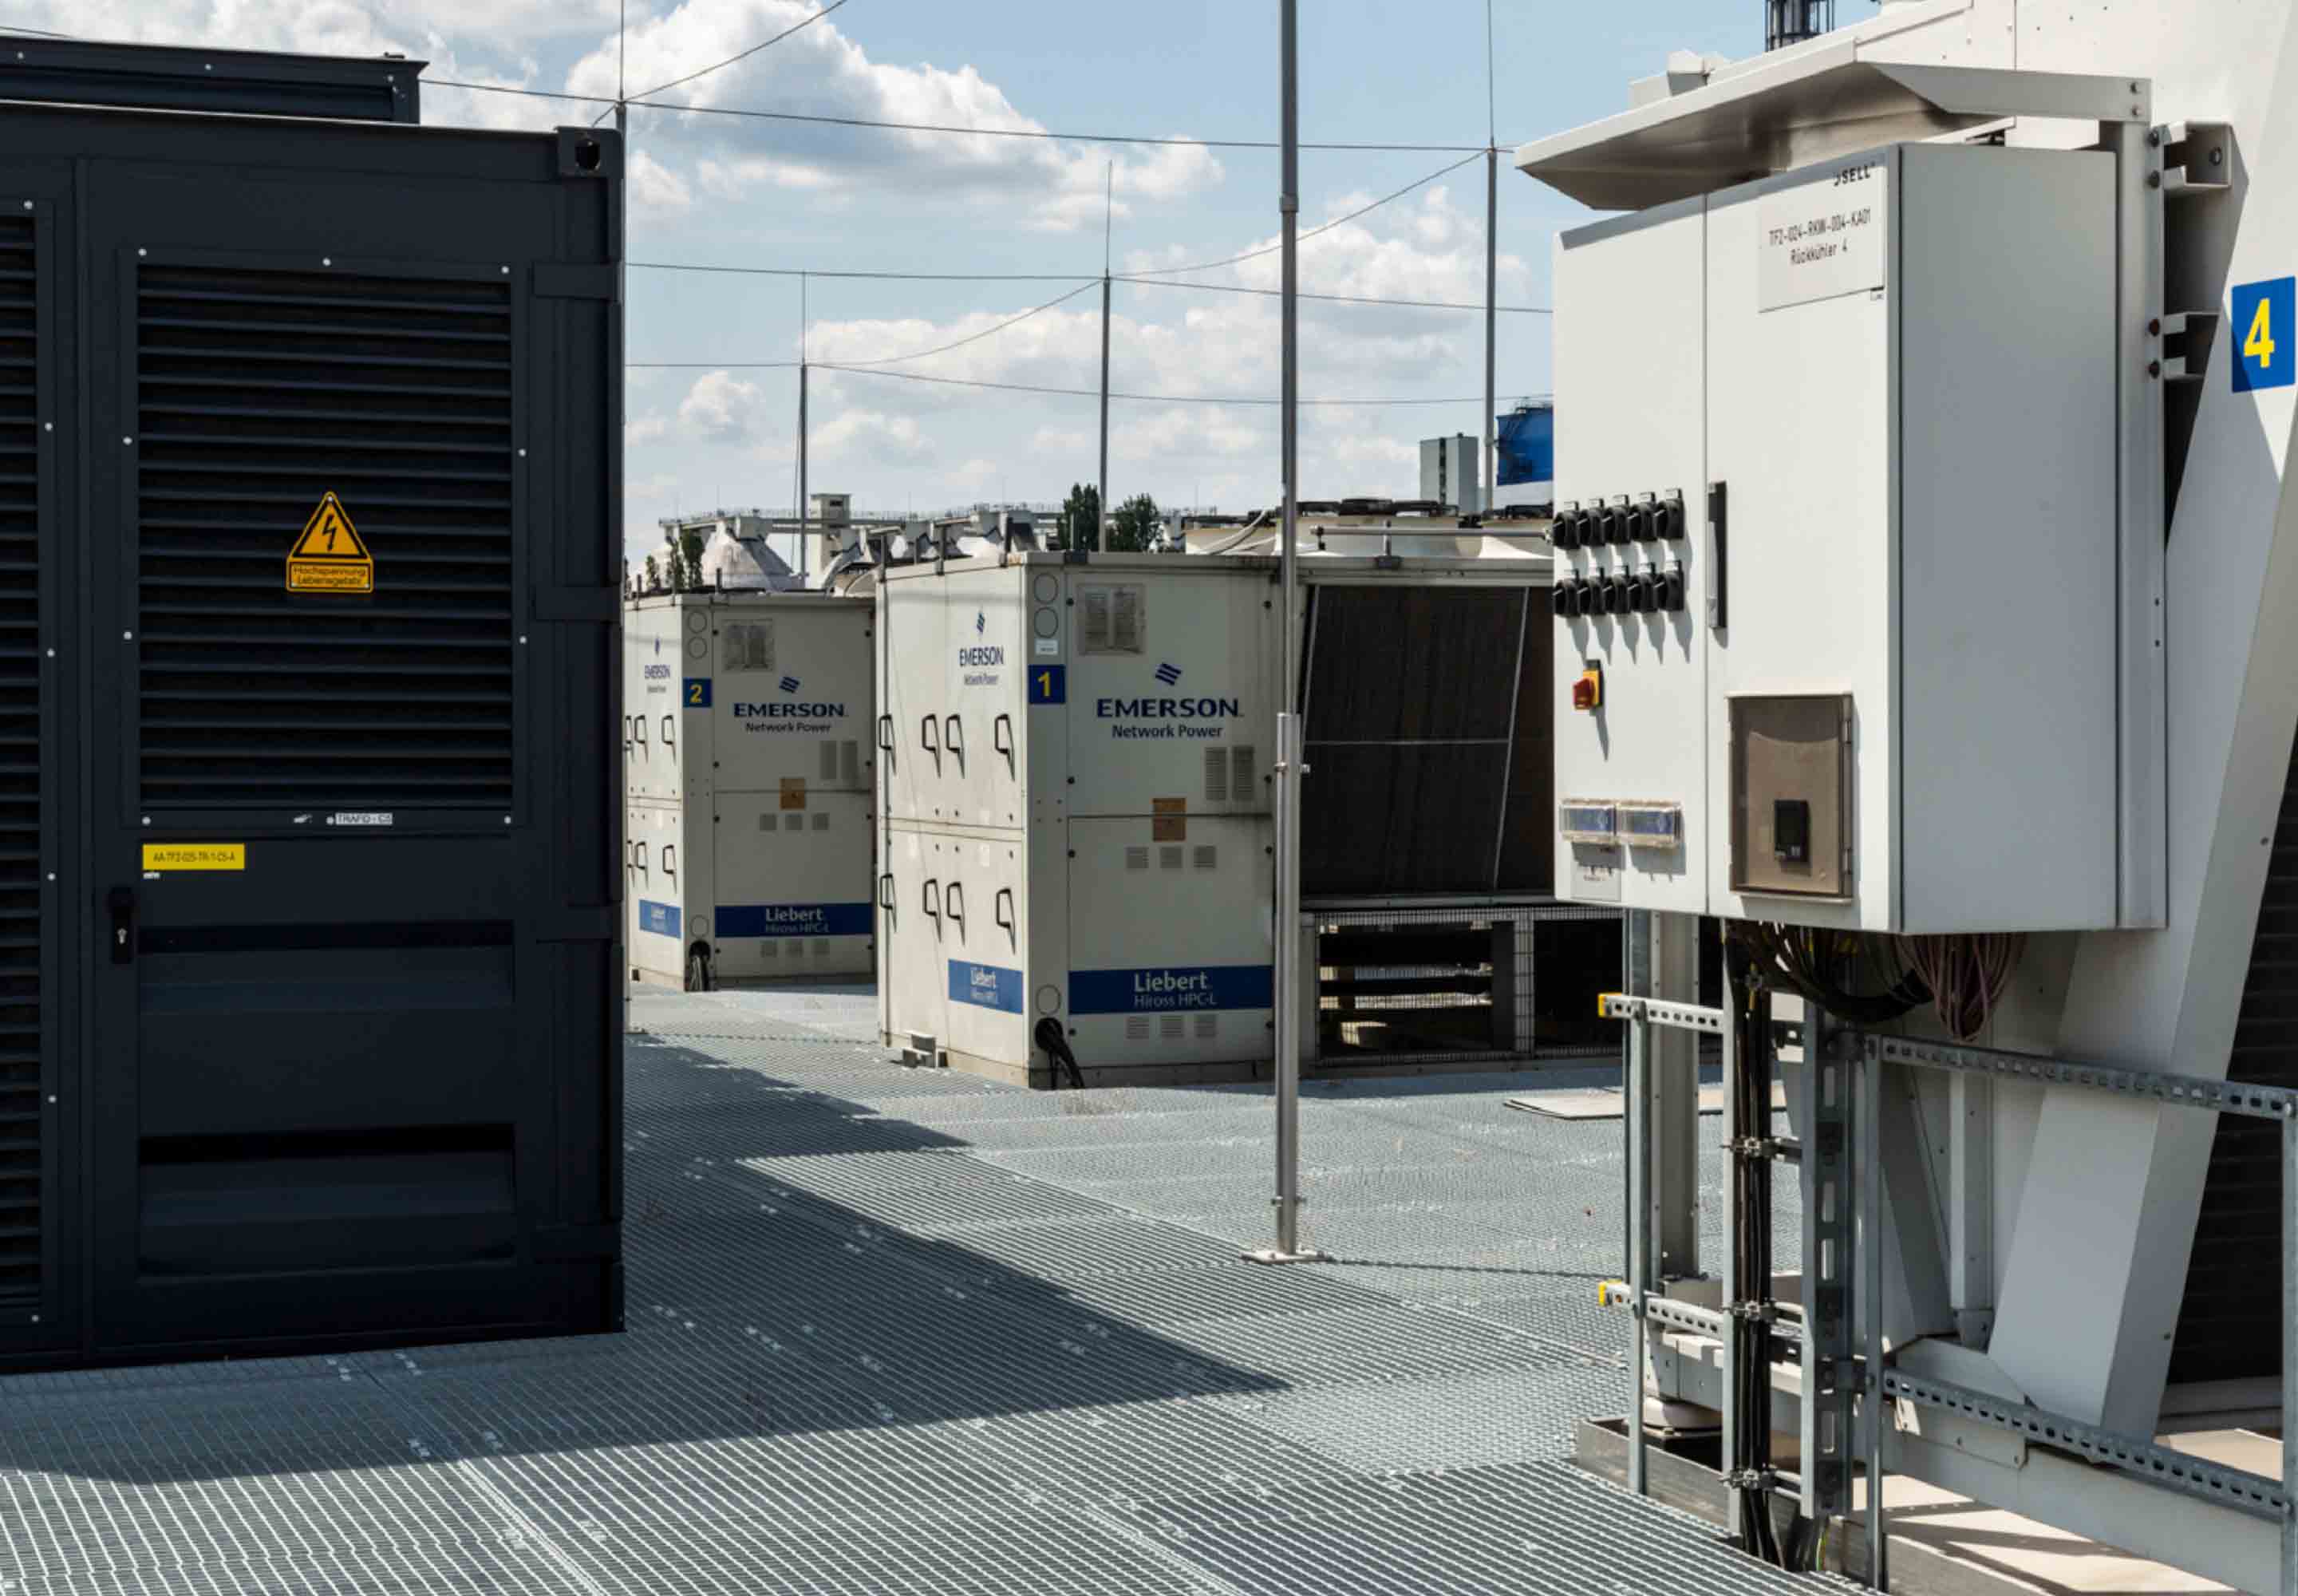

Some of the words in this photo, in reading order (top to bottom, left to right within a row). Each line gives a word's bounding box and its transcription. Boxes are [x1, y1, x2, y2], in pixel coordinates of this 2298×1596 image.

[1842, 238, 1848, 252] 4
[2244, 298, 2275, 368] 4
[959, 646, 1004, 667] EMERSON
[1038, 672, 1050, 697] 1
[690, 684, 702, 703] 2
[733, 703, 844, 717] EMERSON
[1096, 698, 1238, 718] EMERSON
[746, 721, 794, 733] Network
[797, 721, 831, 733] Power
[1111, 725, 1174, 738] Network
[1179, 725, 1224, 738] Power
[766, 906, 823, 922] Liebert
[1135, 970, 1208, 992] Liebert
[1135, 994, 1175, 1008] Hiross
[1179, 992, 1218, 1006] HPC-L
